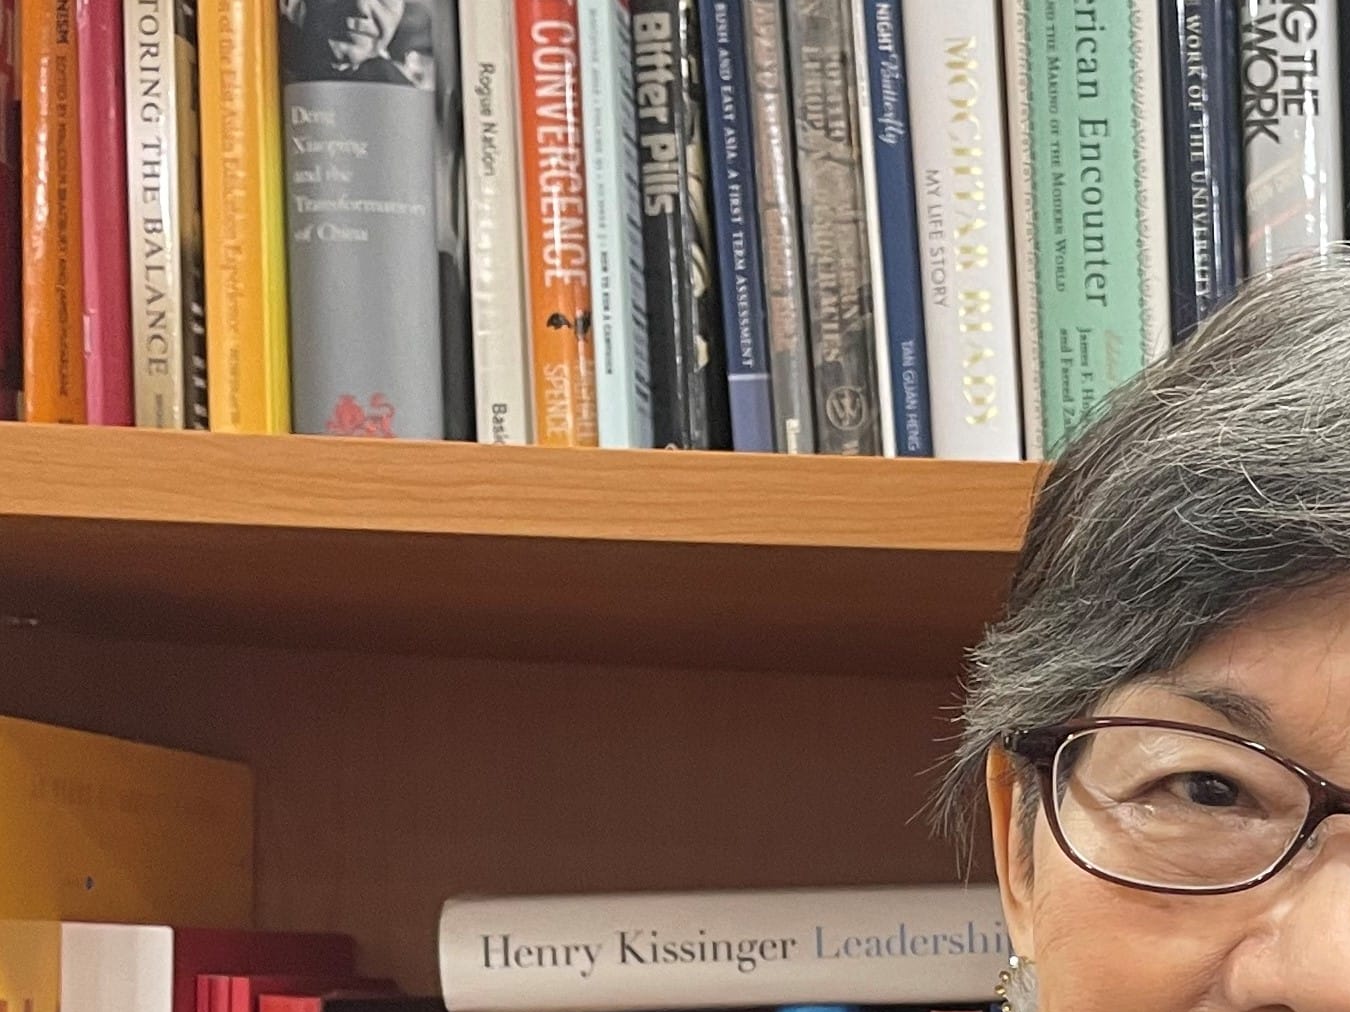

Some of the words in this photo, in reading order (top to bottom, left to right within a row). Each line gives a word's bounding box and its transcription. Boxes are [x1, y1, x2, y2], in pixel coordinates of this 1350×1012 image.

[714, 4, 731, 45] BUSH
[875, 3, 895, 52] NIGHT
[1186, 14, 1205, 77] WORK
[475, 62, 496, 118] Rogue
[632, 13, 674, 125] Bitter
[717, 48, 732, 83] AND
[1242, 13, 1280, 147] WORK
[1282, 50, 1319, 117] THE
[720, 86, 737, 121] EAST
[878, 53, 905, 147] Butterfly
[1188, 86, 1205, 111] OF
[480, 121, 500, 176] Nation
[530, 20, 588, 288] CONVERGENCE
[1189, 120, 1207, 163] THE
[140, 138, 165, 205] THE
[643, 133, 680, 217] Pills
[725, 169, 740, 181] A
[926, 169, 943, 196] MY
[727, 184, 744, 226] FIRST
[928, 205, 944, 240] LIFE
[1078, 117, 1112, 307] Encounter
[730, 231, 746, 271] TERM
[1190, 170, 1212, 299] UNIVERSITY
[142, 218, 169, 378] BALANCE
[931, 247, 949, 308] STORY
[733, 274, 754, 369] ASSESSMENT
[1060, 328, 1074, 353] and
[901, 340, 916, 367] TAN
[1076, 327, 1092, 367] James
[543, 361, 573, 437] SPENCE
[902, 369, 918, 409] GUAN
[1060, 357, 1075, 402] Fareed
[904, 413, 921, 451] HENG
[480, 932, 603, 979] Henry
[616, 928, 800, 974] Kissinger
